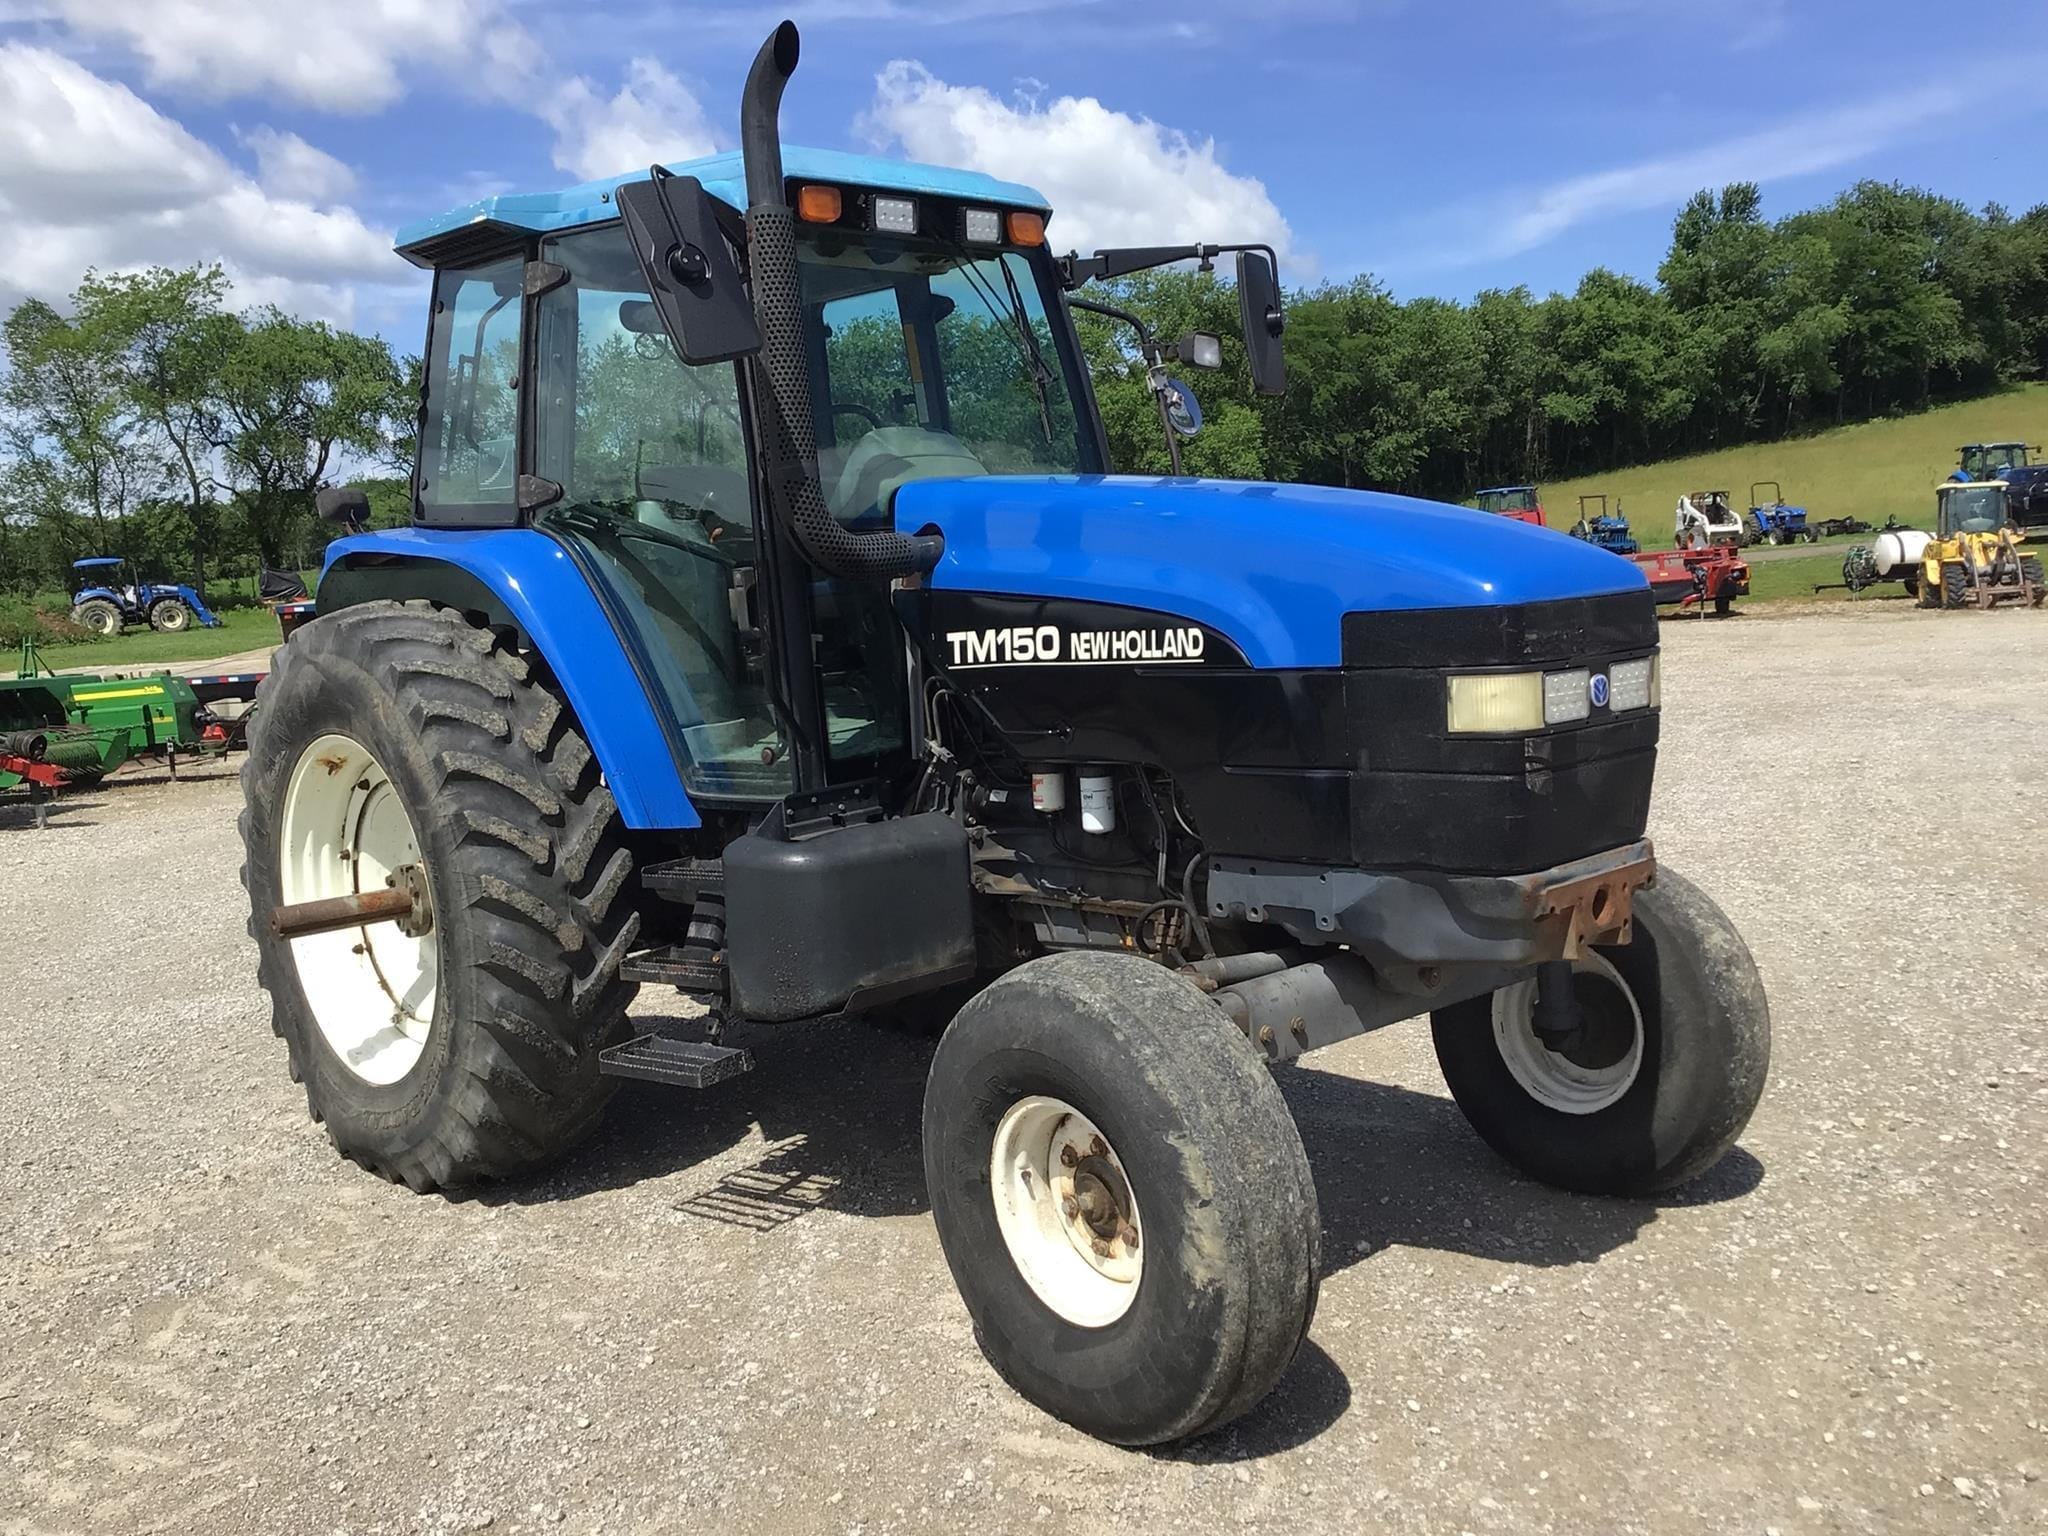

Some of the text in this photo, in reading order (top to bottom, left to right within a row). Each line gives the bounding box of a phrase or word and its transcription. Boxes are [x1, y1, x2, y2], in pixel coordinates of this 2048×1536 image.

[946, 625, 1204, 664] TM150 NEW HOLLAND
